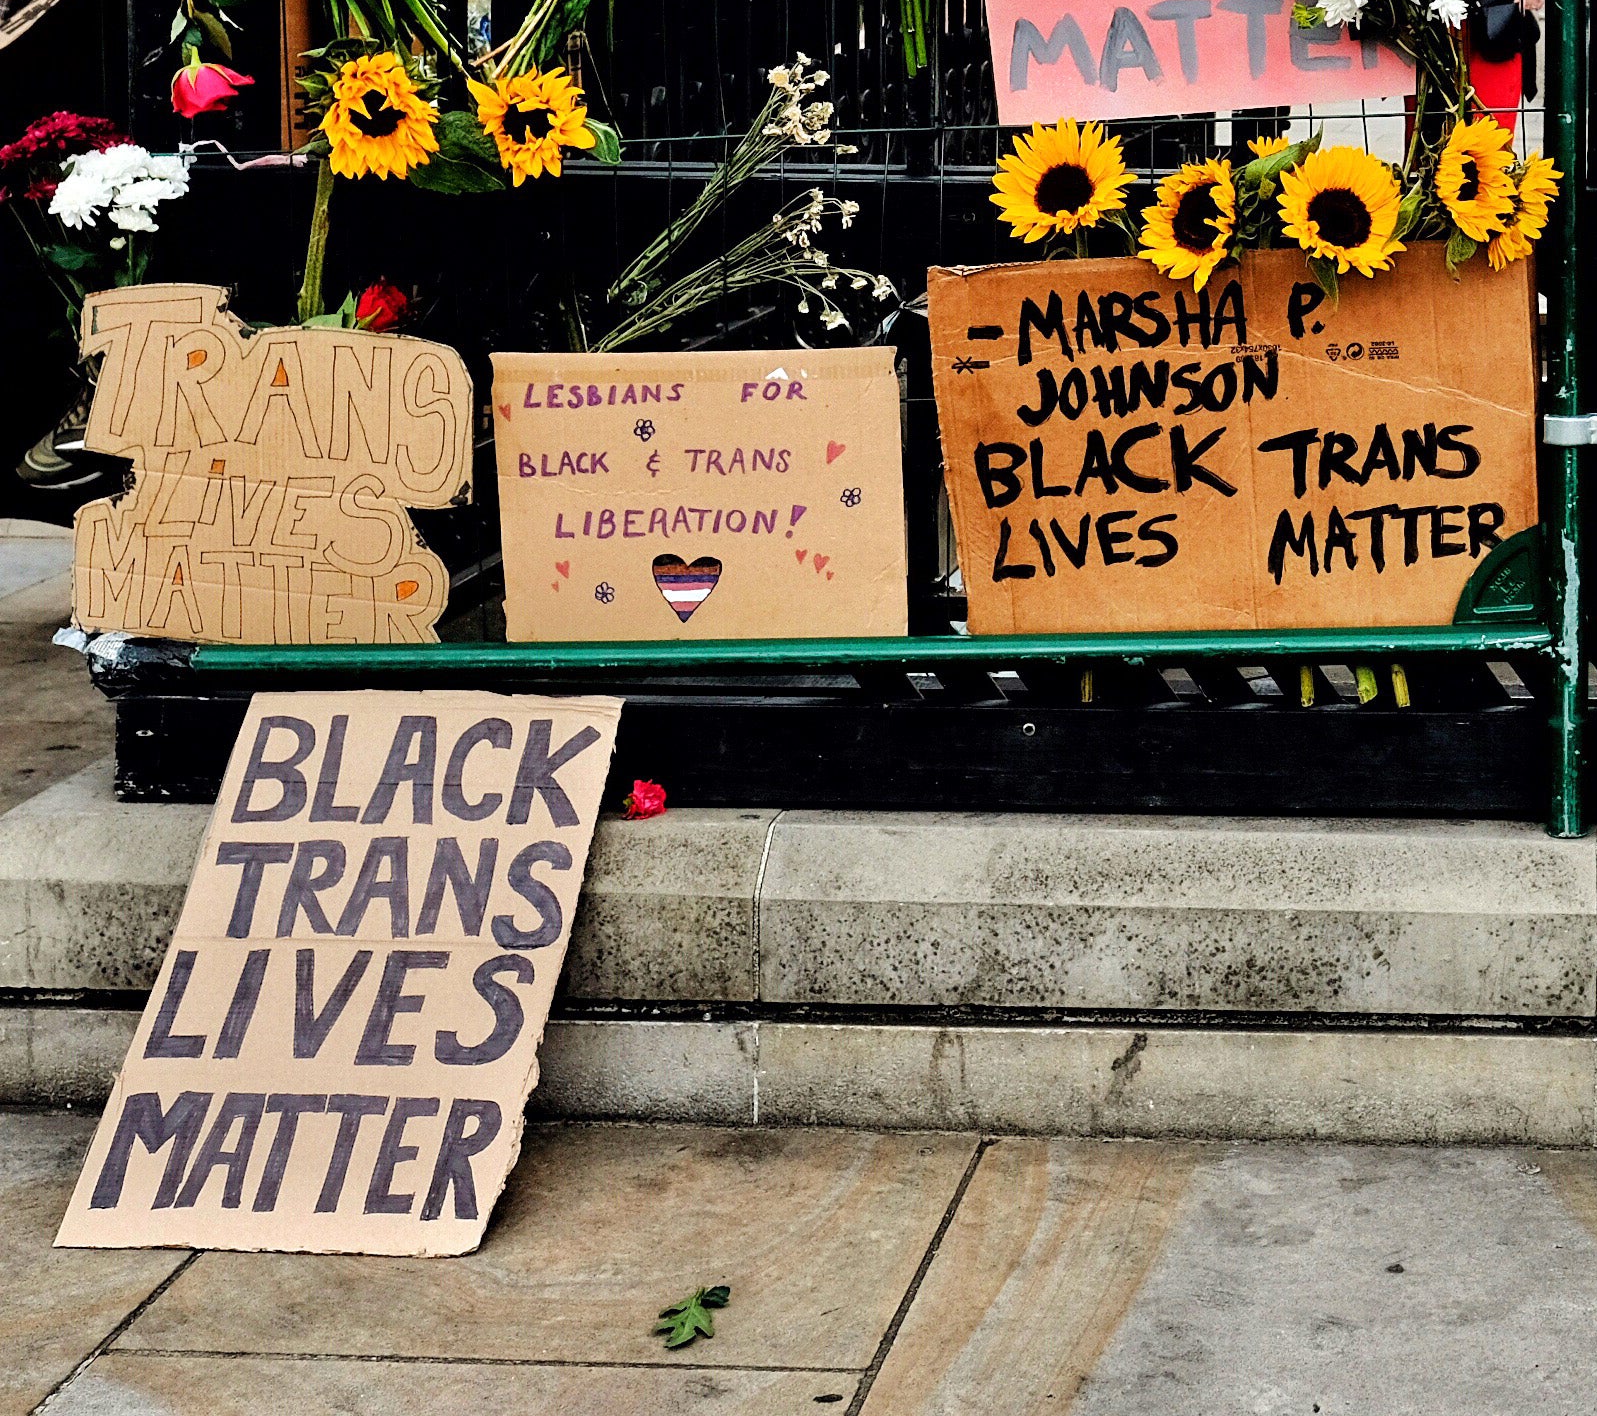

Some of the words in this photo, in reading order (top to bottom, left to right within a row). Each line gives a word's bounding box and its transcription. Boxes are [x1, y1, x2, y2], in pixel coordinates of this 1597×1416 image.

[1016, 279, 1249, 366] MARSHA
[1287, 281, 1328, 340] P.
[91, 297, 457, 493] TRANS
[523, 382, 685, 409] LESBIANS
[740, 380, 807, 403] FOR
[1016, 348, 1280, 428] JOHNSON
[518, 451, 611, 478] BLACK
[646, 450, 661, 477] &
[684, 448, 792, 476] TRANS
[974, 421, 1239, 509] BLACK
[1258, 422, 1482, 499] TRANS
[555, 505, 807, 539] LIBERATION!
[991, 510, 1179, 583] LIVES
[1267, 501, 1508, 585] MATTER
[88, 519, 440, 644] MATTER
[230, 714, 602, 828] BLACK
[215, 836, 573, 950] TRANS
[143, 948, 535, 1066] LIVES
[90, 1091, 503, 1221] MATTER
